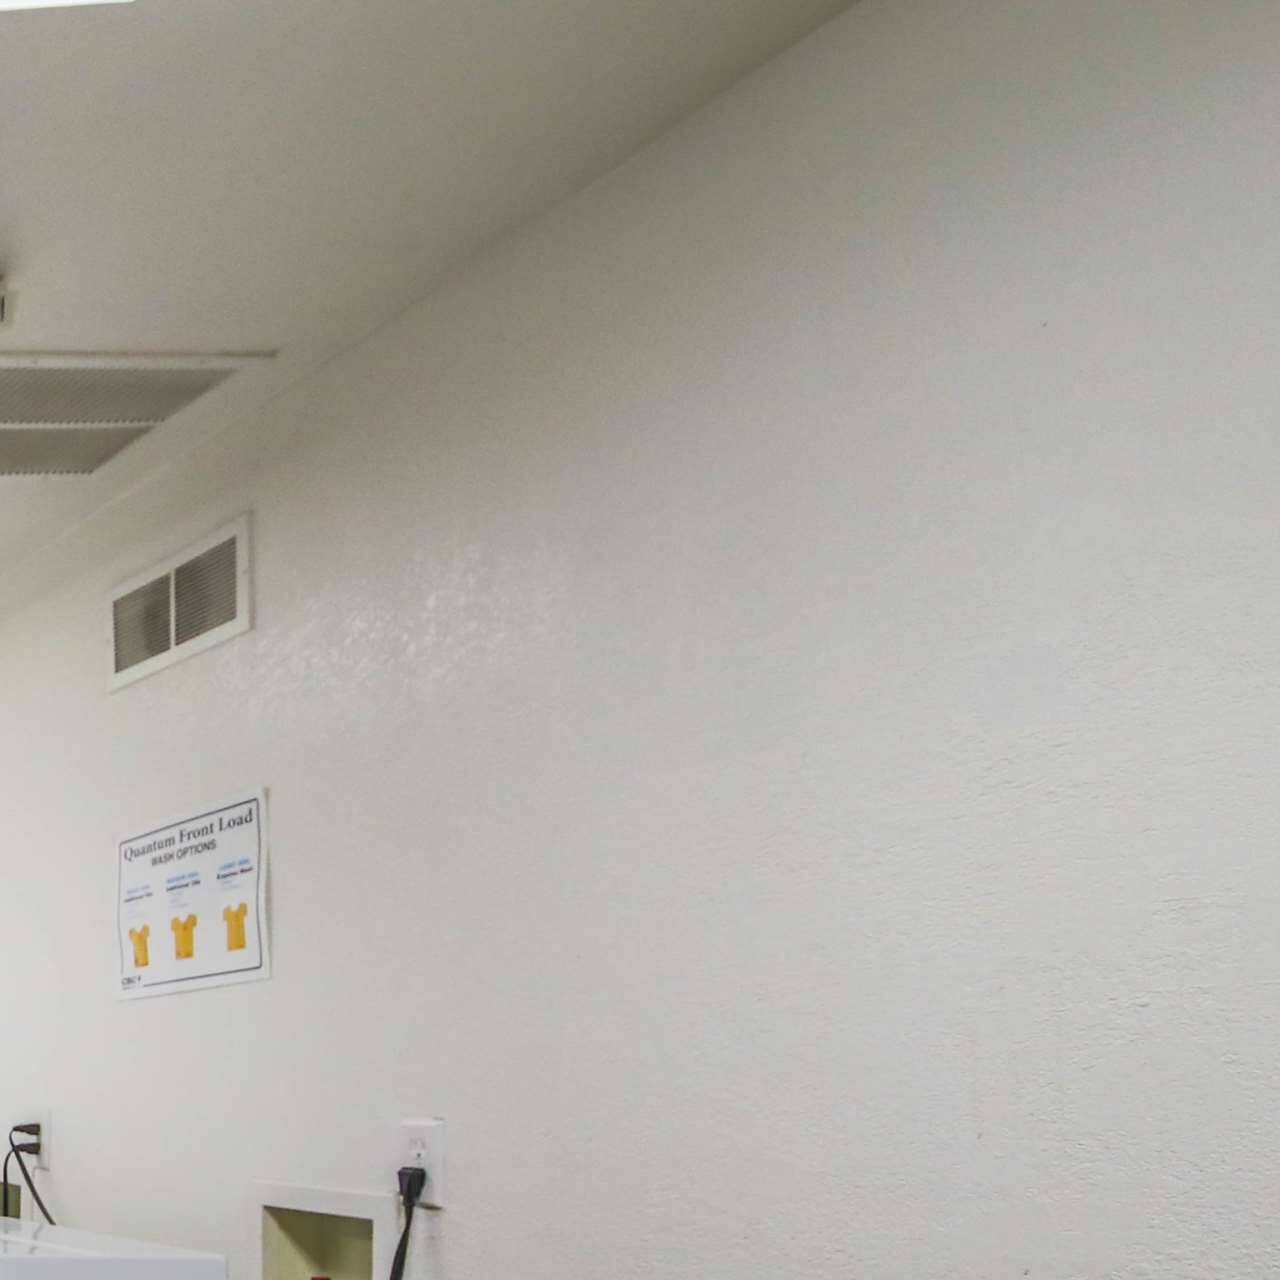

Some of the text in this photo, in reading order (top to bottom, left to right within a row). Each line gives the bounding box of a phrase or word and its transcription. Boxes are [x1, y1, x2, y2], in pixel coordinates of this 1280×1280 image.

[123, 807, 254, 862] Quantum Front Load
[175, 838, 218, 860] OPTIONS
